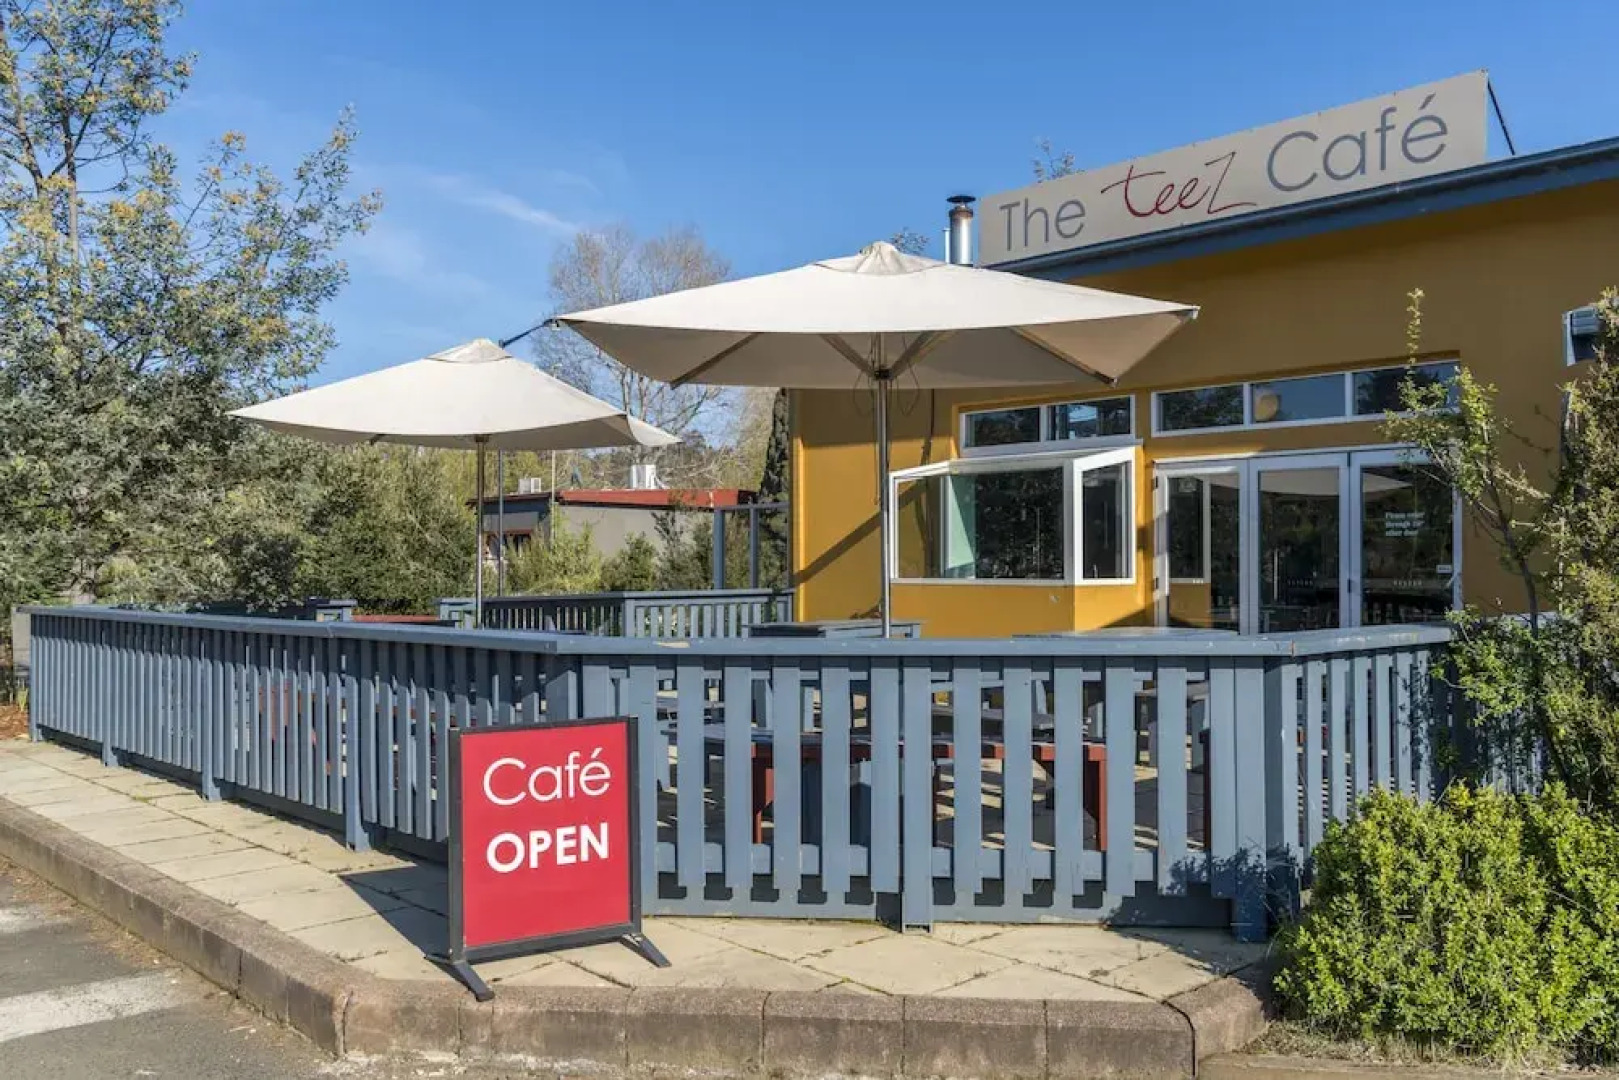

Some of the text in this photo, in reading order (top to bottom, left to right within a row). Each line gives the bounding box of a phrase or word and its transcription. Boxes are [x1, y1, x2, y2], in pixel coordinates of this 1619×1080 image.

[999, 198, 1086, 251] The
[1267, 93, 1449, 192] Café
[483, 747, 612, 806] Café
[486, 822, 610, 873] OPEN
